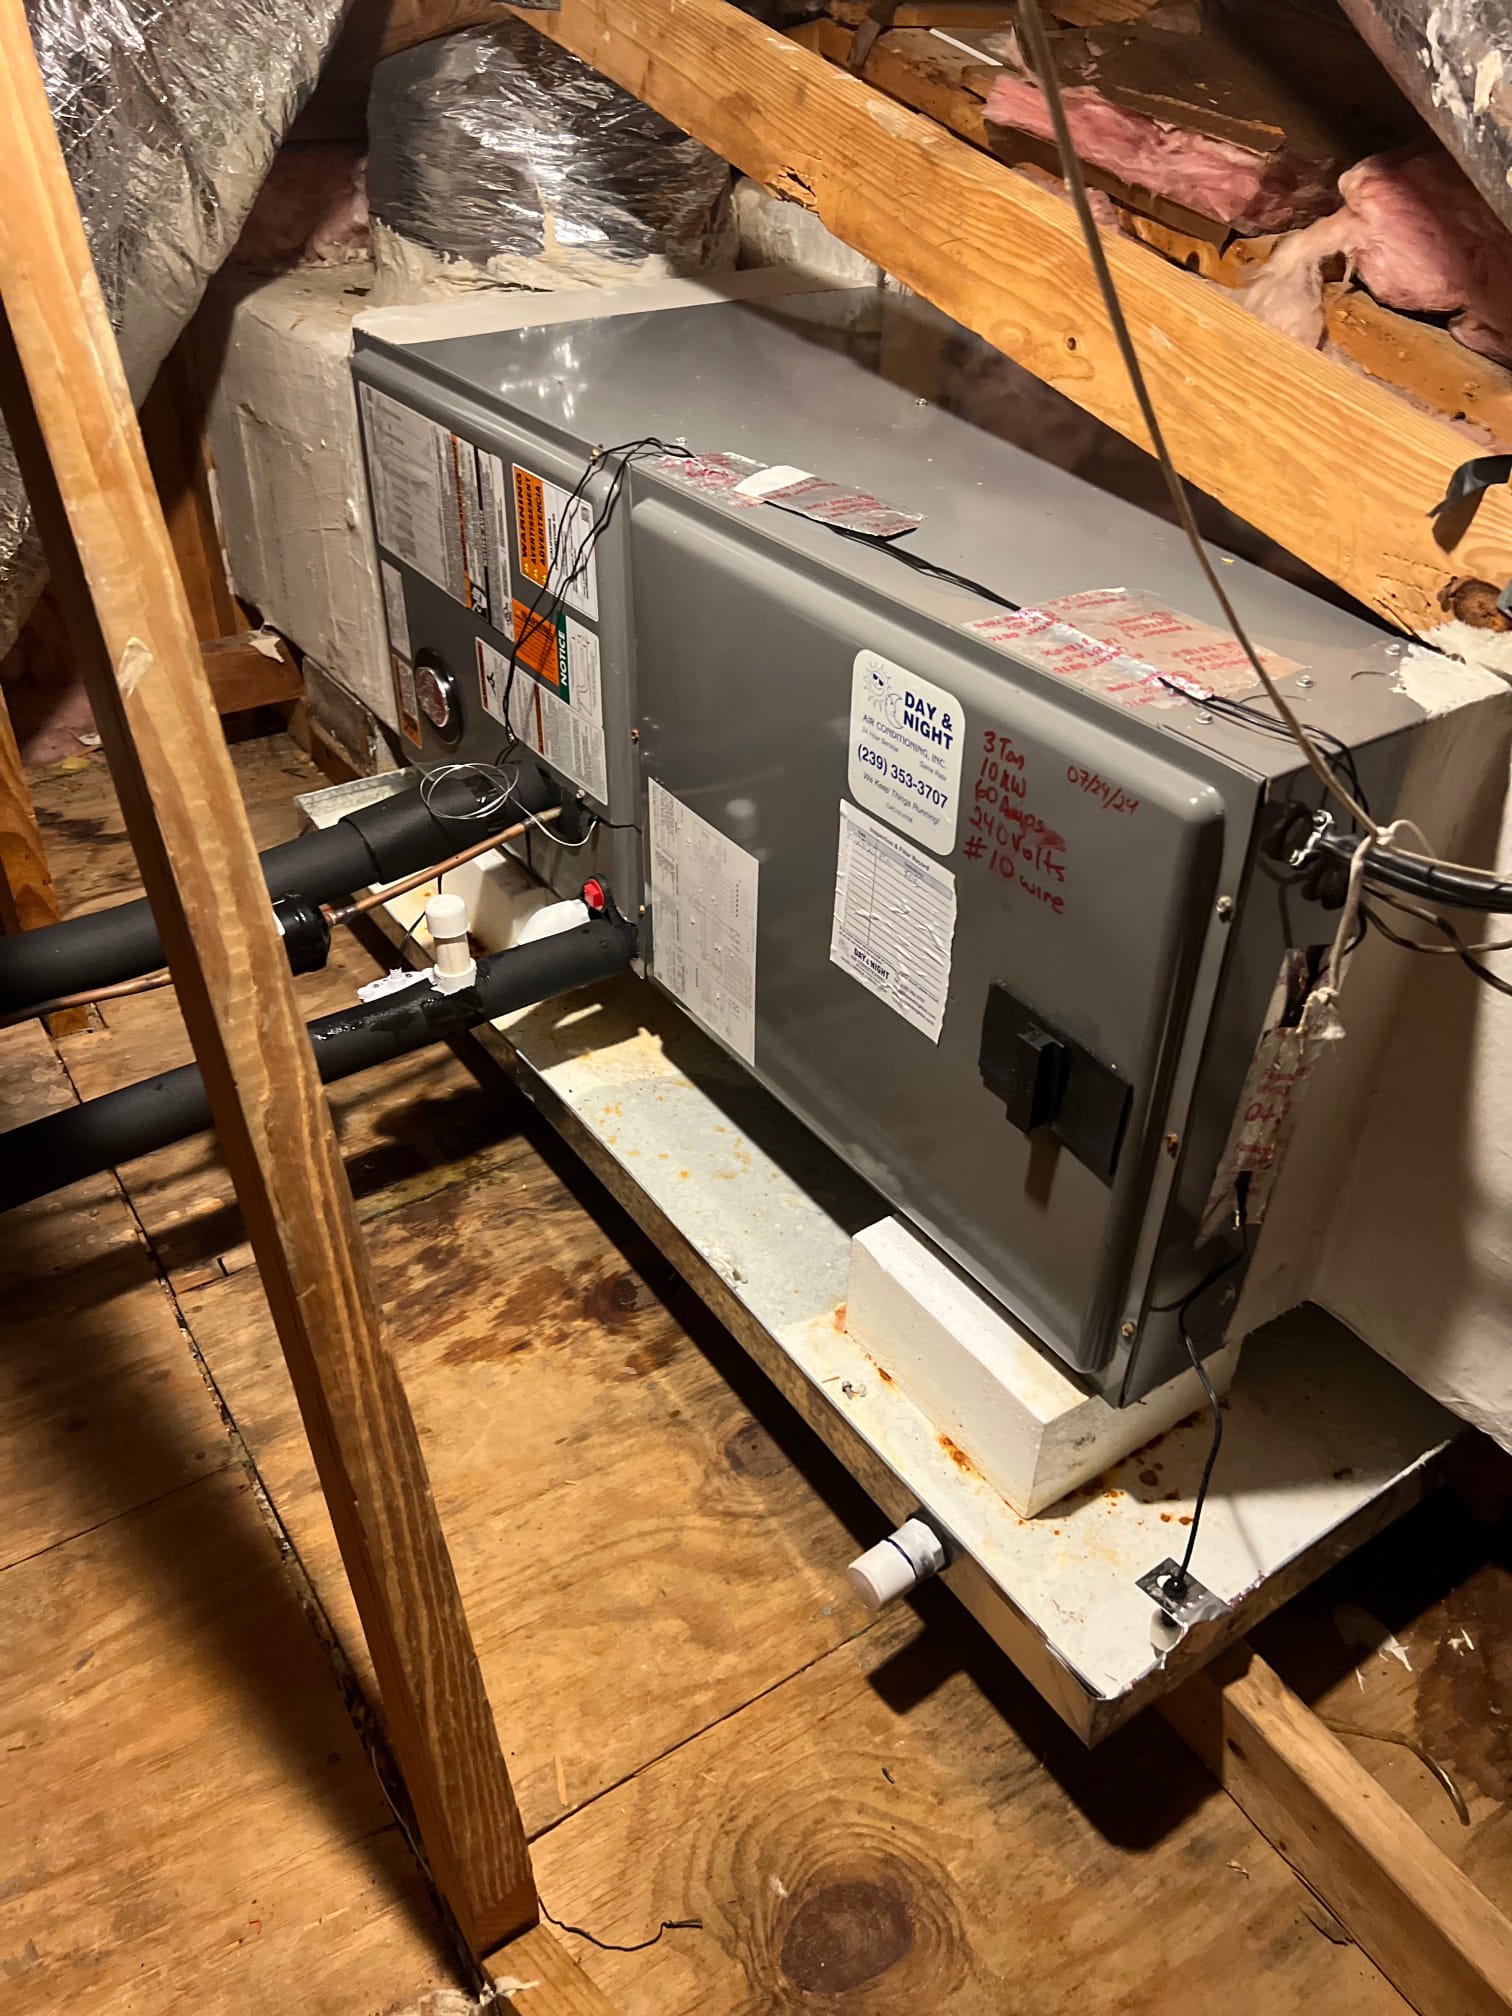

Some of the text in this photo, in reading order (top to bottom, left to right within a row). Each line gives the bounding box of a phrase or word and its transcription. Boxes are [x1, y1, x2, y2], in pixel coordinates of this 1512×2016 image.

[515, 472, 528, 559] WARNING
[534, 484, 546, 566] ADVERTENCIA
[558, 630, 569, 686] NOTICE
[903, 711, 954, 750] NIGHT
[905, 691, 953, 732] DAY &
[863, 714, 875, 729] AIR
[932, 753, 947, 770] INC.
[984, 731, 1025, 770] 3 Ton
[857, 743, 949, 809] (239) 353-3707
[974, 778, 998, 804] 60
[981, 757, 999, 781] 10
[1066, 765, 1141, 816] 07/24/24
[863, 771, 874, 785] We
[875, 779, 890, 796] Keep
[891, 786, 911, 809] Things
[912, 802, 940, 826] Running!
[968, 805, 1066, 882] 240 Volts
[1019, 875, 1065, 915] wire
[854, 947, 866, 962] DAY
[869, 959, 890, 980] NIGHT
